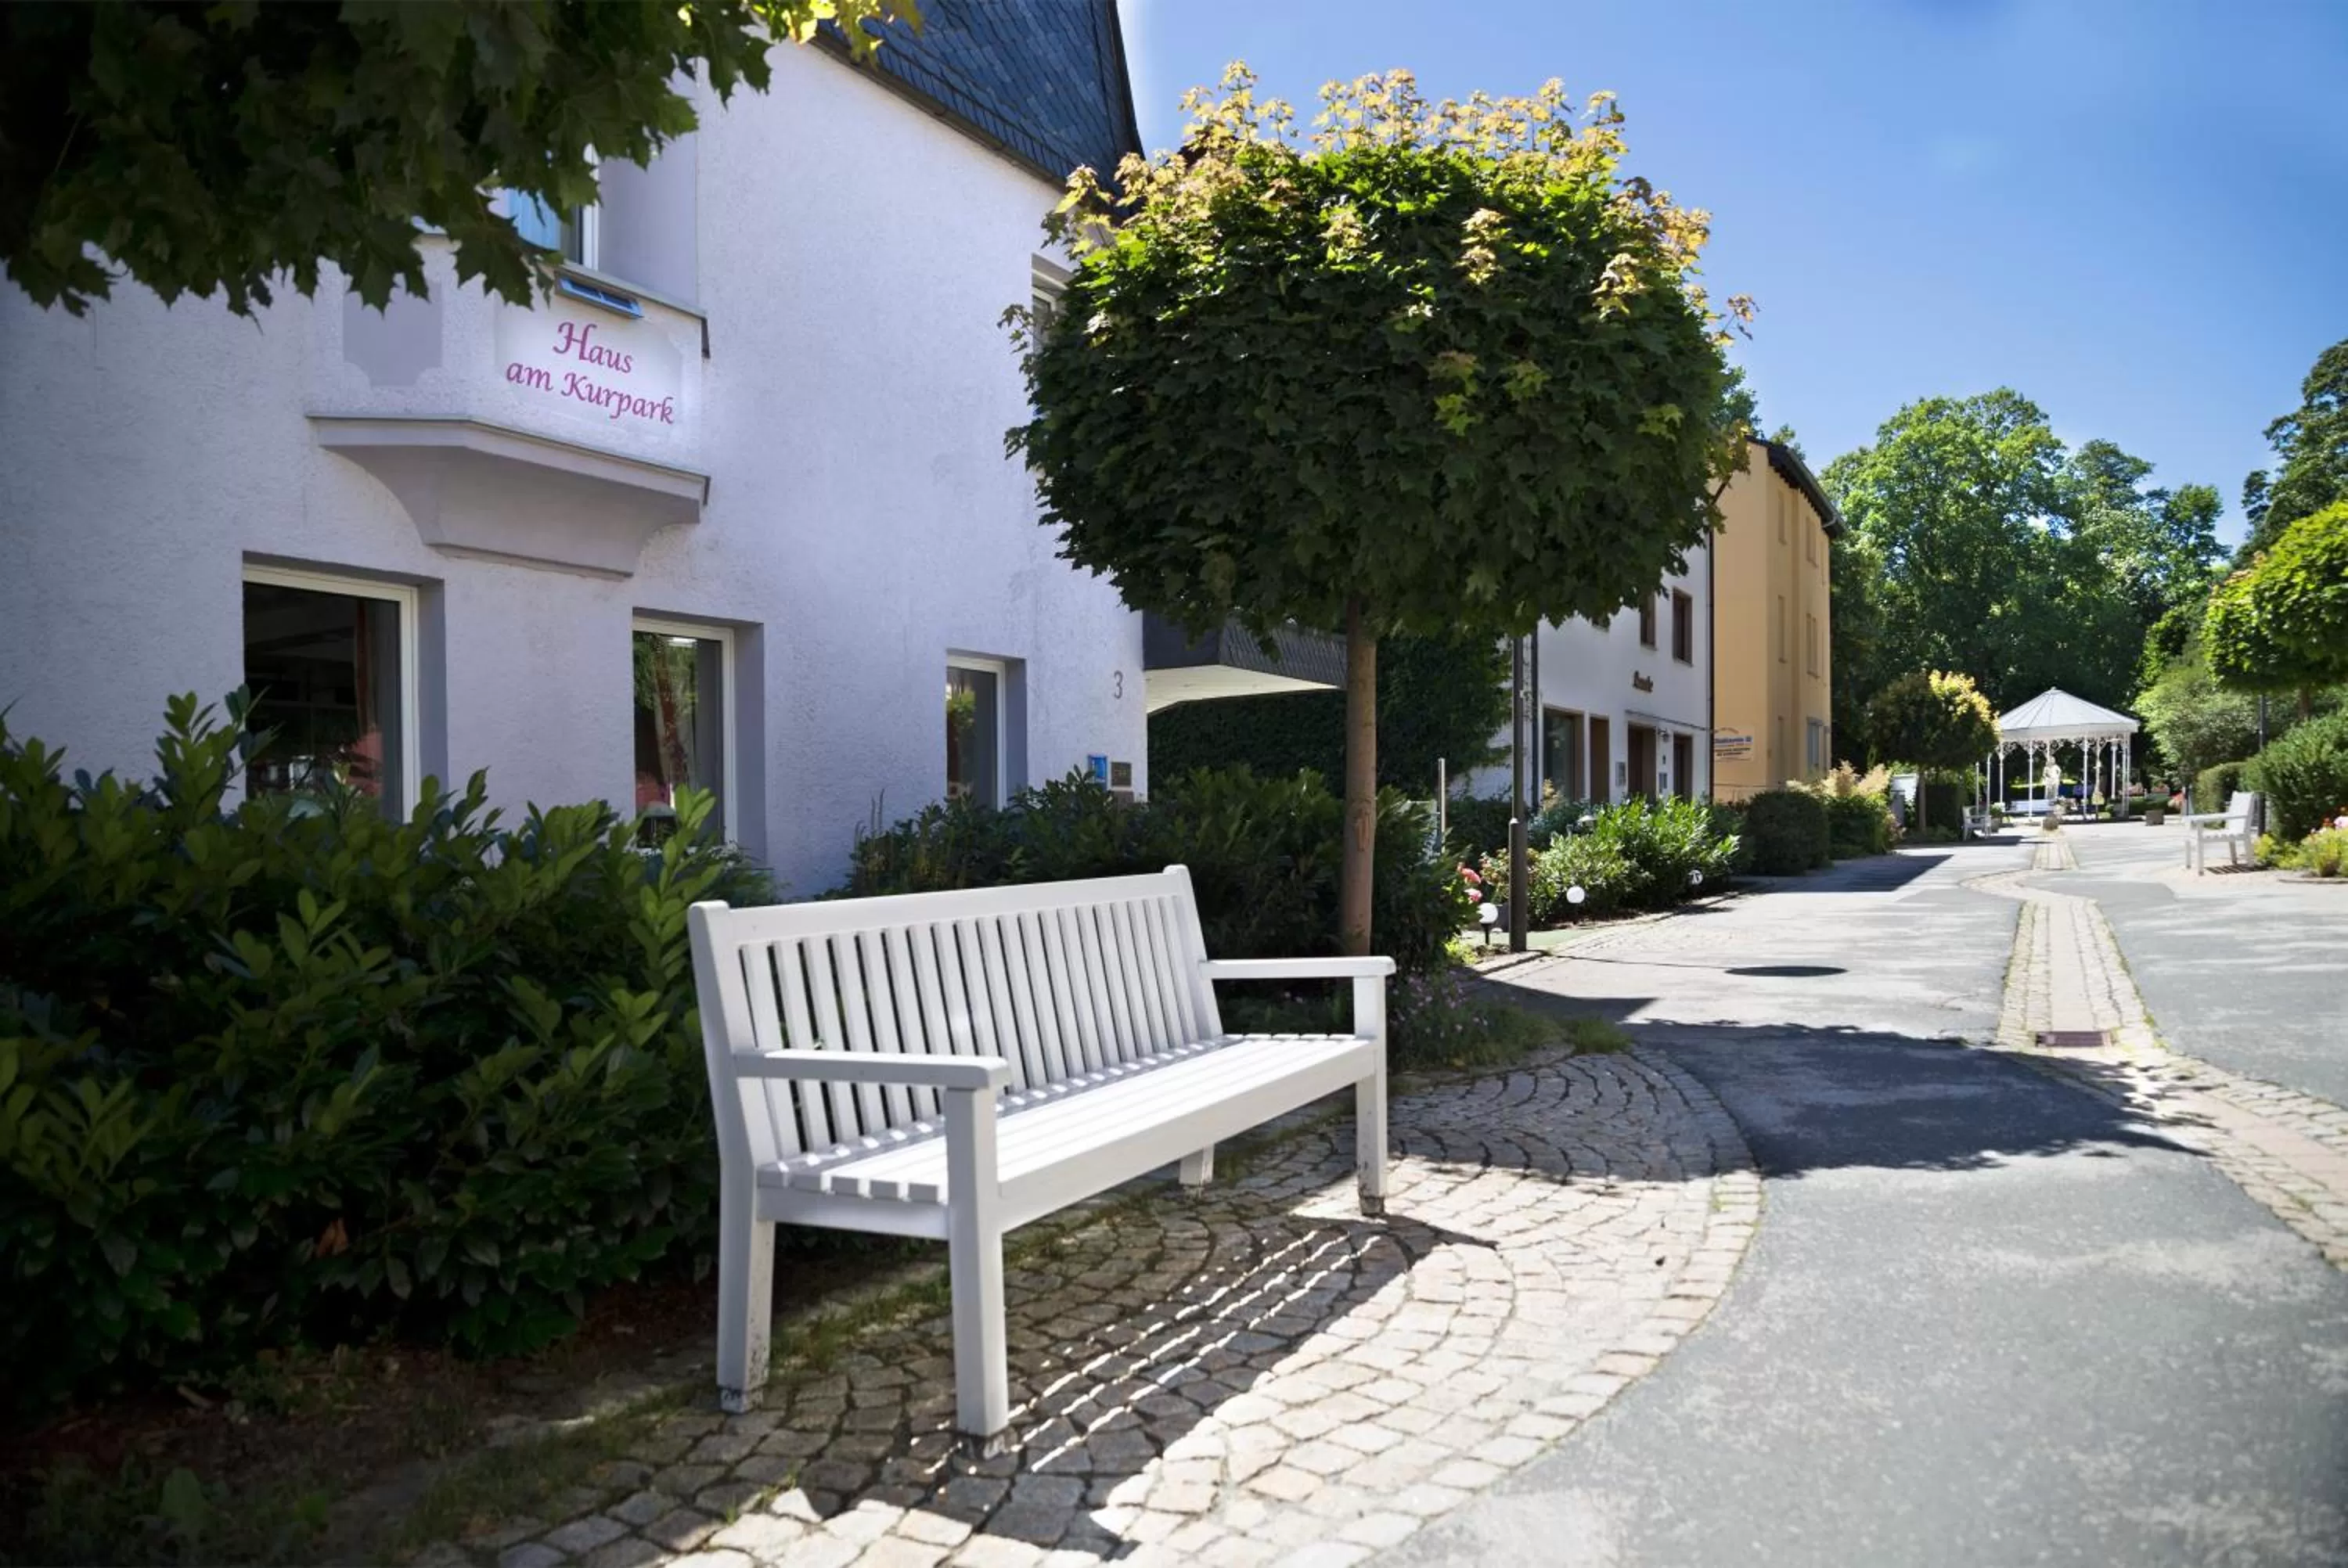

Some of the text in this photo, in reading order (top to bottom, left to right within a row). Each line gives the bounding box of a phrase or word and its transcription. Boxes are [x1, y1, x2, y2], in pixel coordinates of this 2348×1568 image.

[552, 322, 633, 373] Haus
[506, 361, 675, 425] am Kurpark
[1113, 670, 1123, 699] 3
